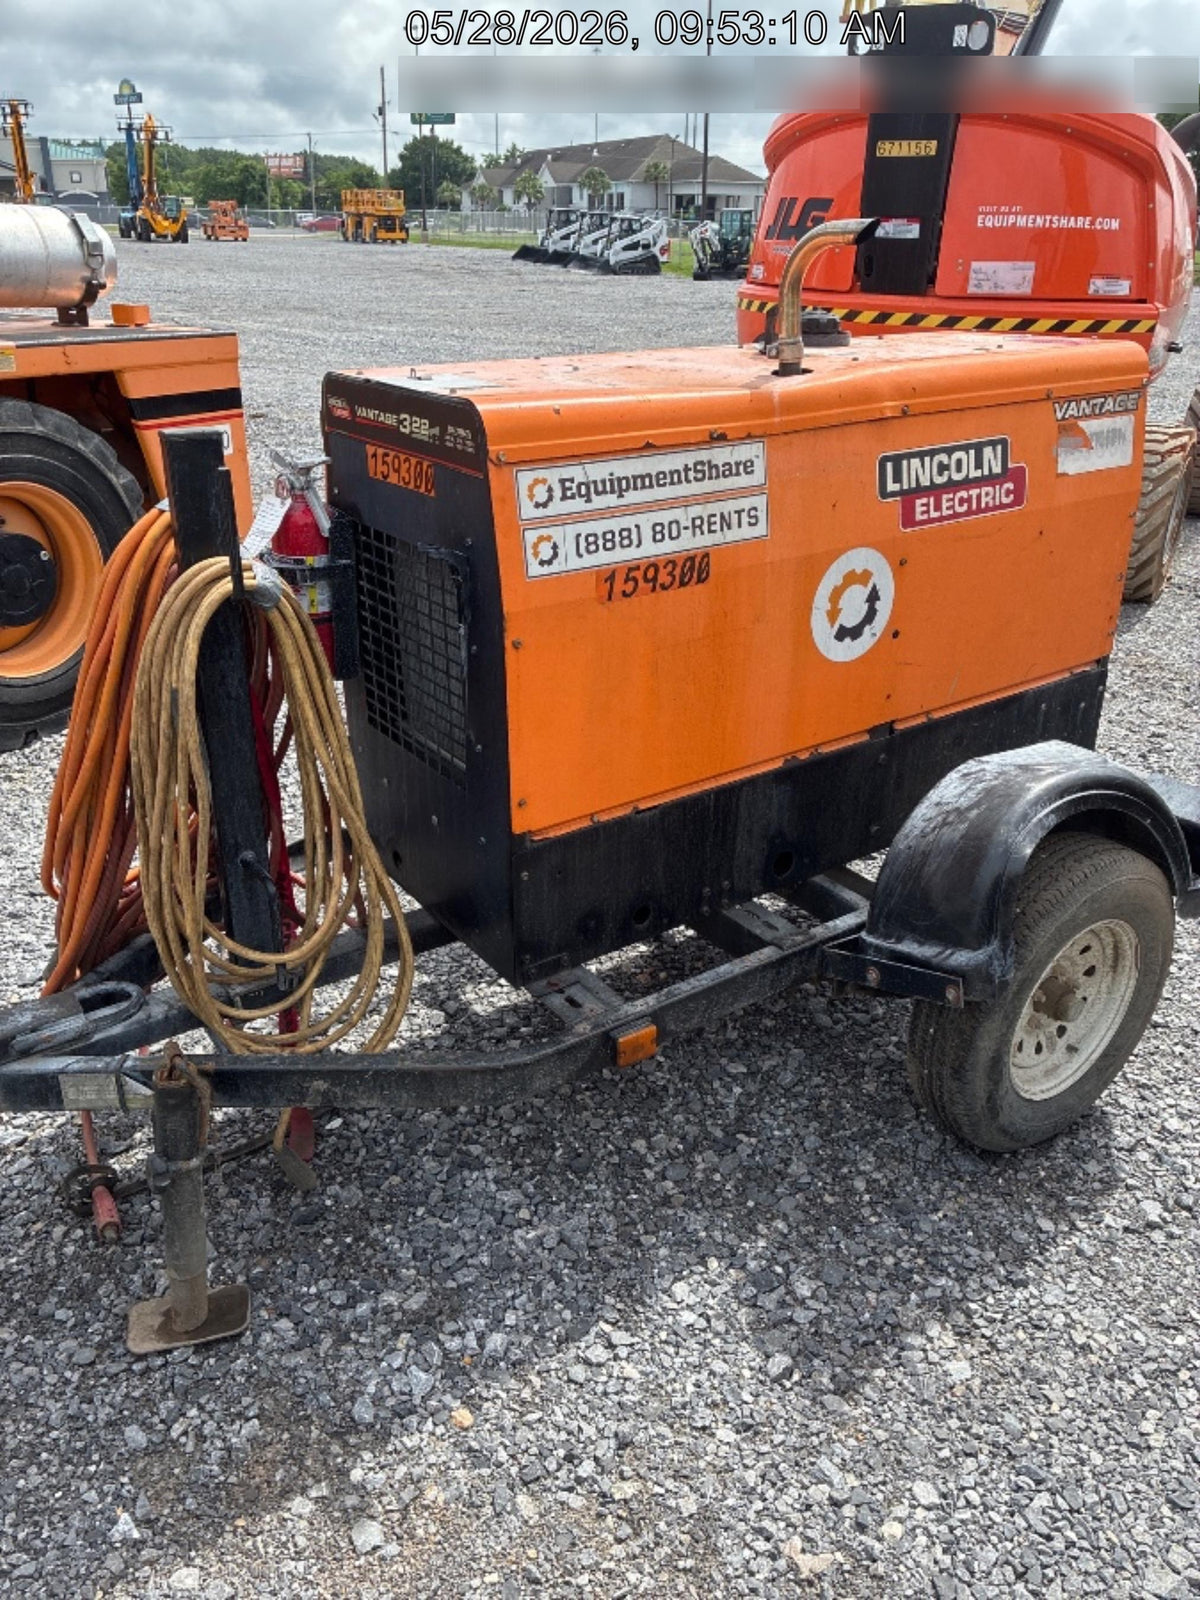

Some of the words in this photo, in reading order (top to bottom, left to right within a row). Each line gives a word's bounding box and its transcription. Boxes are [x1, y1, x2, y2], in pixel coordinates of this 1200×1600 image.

[878, 142, 932, 156] 671156
[764, 197, 834, 241] JLG
[977, 215, 1120, 231] EQUIPMENTSHARE.COM
[355, 404, 398, 426] VANTAGE
[1053, 391, 1140, 421] VANTAGE
[370, 447, 435, 494] 159300
[558, 458, 755, 503] EquipmentShare
[886, 444, 1002, 493] LINCOLN
[915, 482, 1015, 521] ELECTRIC
[575, 524, 642, 559] (888)
[652, 506, 759, 543] 80-RENTS
[604, 552, 710, 602] 159300
